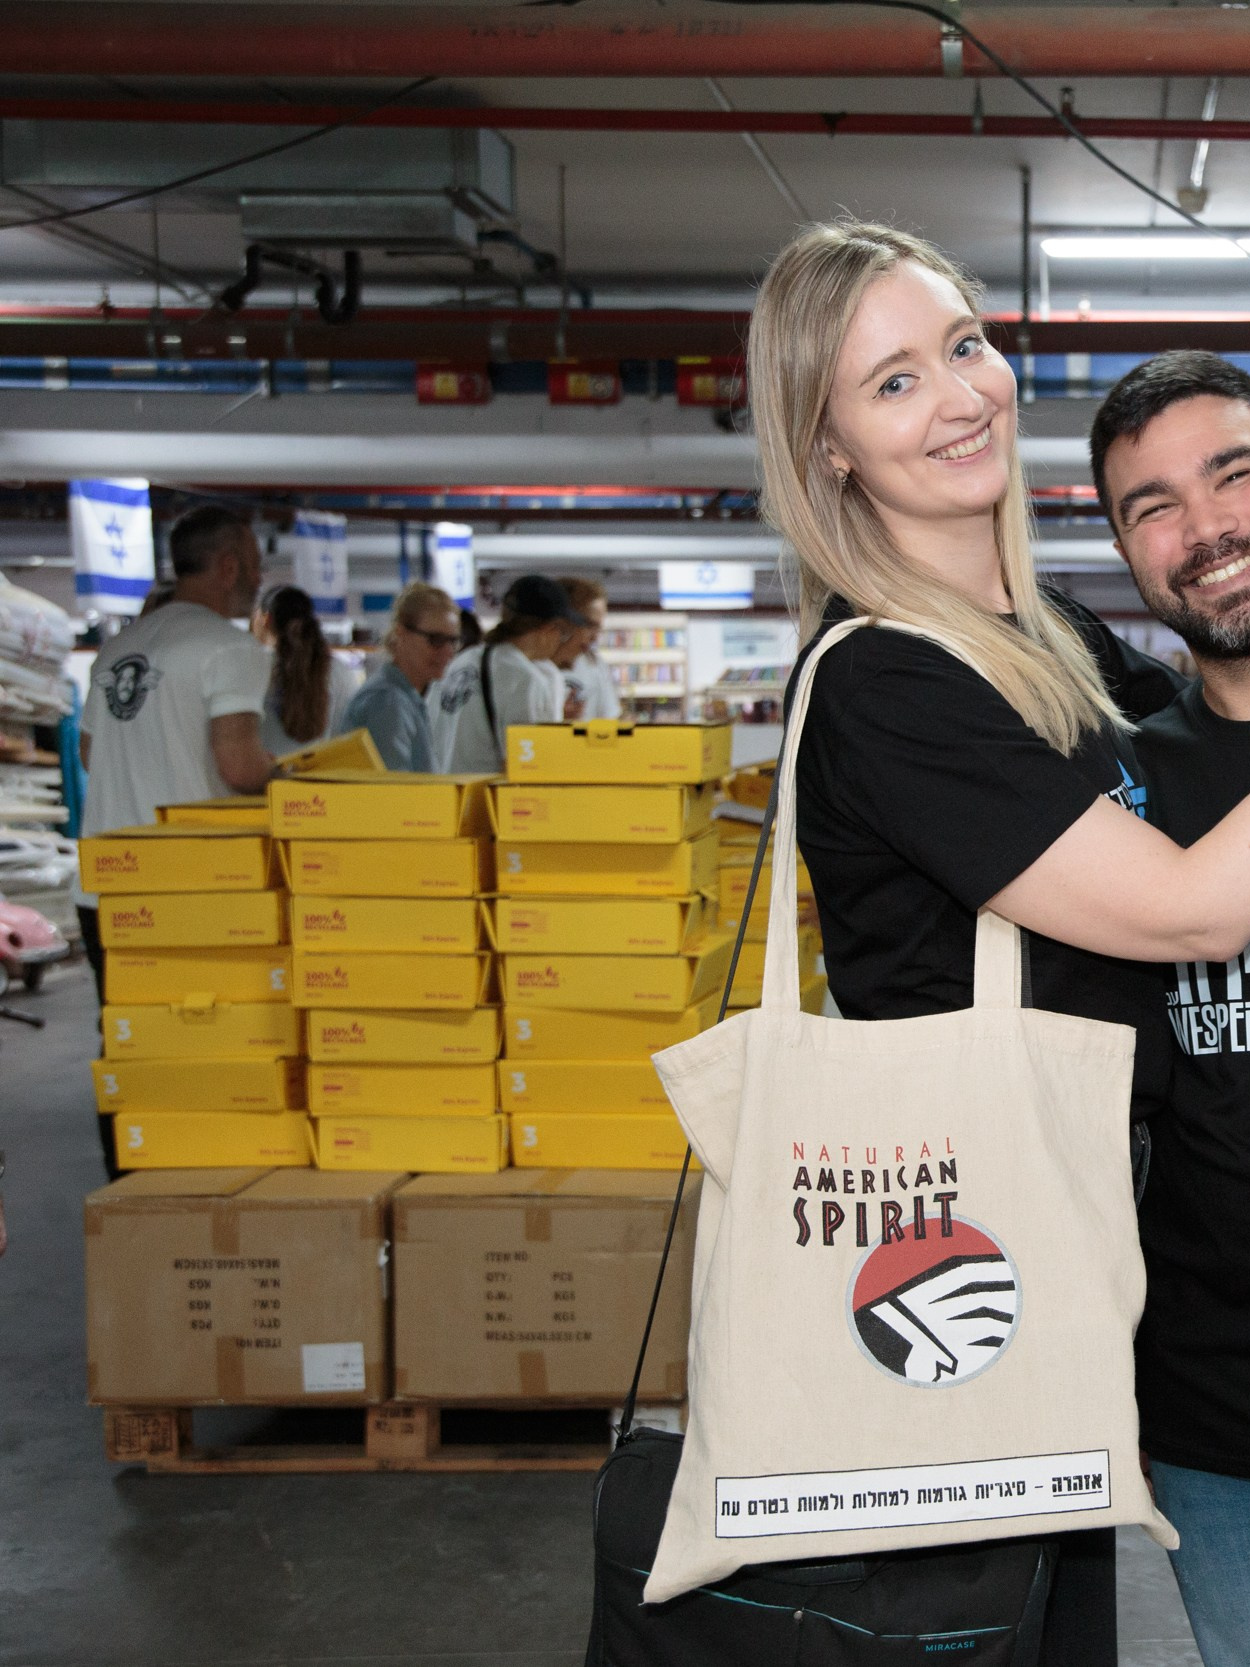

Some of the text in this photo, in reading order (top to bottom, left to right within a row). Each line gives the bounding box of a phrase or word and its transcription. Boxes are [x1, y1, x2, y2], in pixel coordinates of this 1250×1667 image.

[519, 740, 535, 762] 3
[283, 800, 311, 810] 100%
[96, 856, 124, 866] 100%
[507, 852, 522, 873] 3
[112, 912, 139, 921] 100%
[303, 914, 331, 925] 100%
[306, 971, 333, 981] 100%
[517, 971, 544, 981] 100%
[116, 1019, 132, 1040] 3
[322, 1027, 350, 1037] 100%
[516, 1019, 532, 1040] 3
[103, 1075, 119, 1094] 3
[511, 1072, 526, 1093] 3
[128, 1126, 144, 1147] 3
[522, 1125, 538, 1148] 3
[792, 1137, 954, 1165] NATURAL
[792, 1158, 958, 1194] AMERICAN
[793, 1191, 958, 1247] SPIRIT
[255, 1337, 282, 1349] ITEM
[975, 1480, 1026, 1500] סיגריות
[1051, 1473, 1103, 1493] אזהרה
[797, 1493, 844, 1512] ולמוות
[851, 1488, 909, 1510] למחלות
[916, 1485, 968, 1505] גורמות
[721, 1500, 740, 1516] עת
[747, 1497, 790, 1516] בטרם
[925, 1640, 976, 1652] MIRACASE
